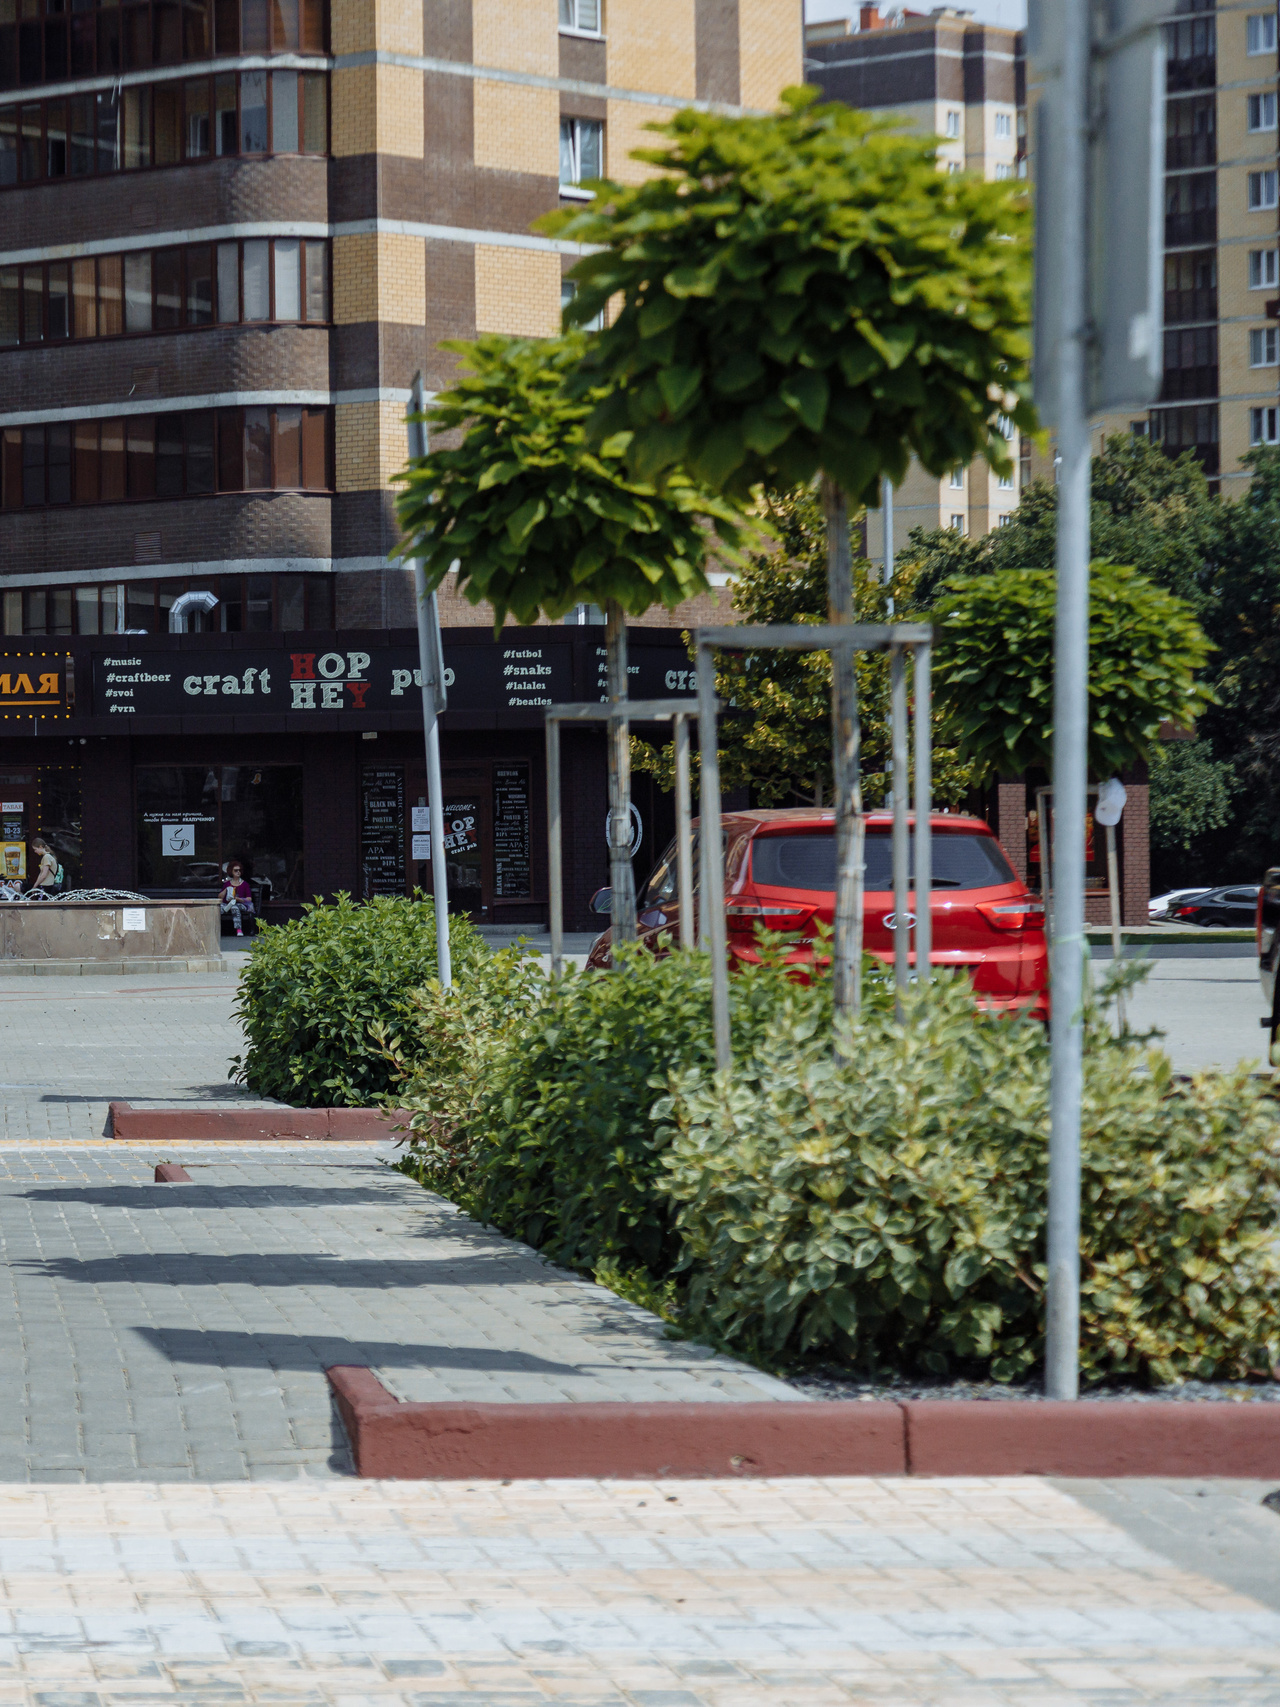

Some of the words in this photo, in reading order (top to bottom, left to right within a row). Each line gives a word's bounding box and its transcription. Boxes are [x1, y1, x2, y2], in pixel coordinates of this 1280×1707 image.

[503, 649, 542, 659] #futbol
[103, 657, 142, 667] #music
[290, 652, 370, 679] HOP
[503, 664, 552, 675] #snaks
[106, 673, 171, 683] #craftbeer
[183, 667, 271, 695] craft
[105, 689, 134, 697] #svoi
[290, 683, 371, 709] HEY
[508, 697, 552, 706] #beatles
[109, 704, 136, 713] #vrn
[445, 804, 473, 812] WELCOME
[451, 846, 466, 855] craft
[466, 842, 478, 851] pub
